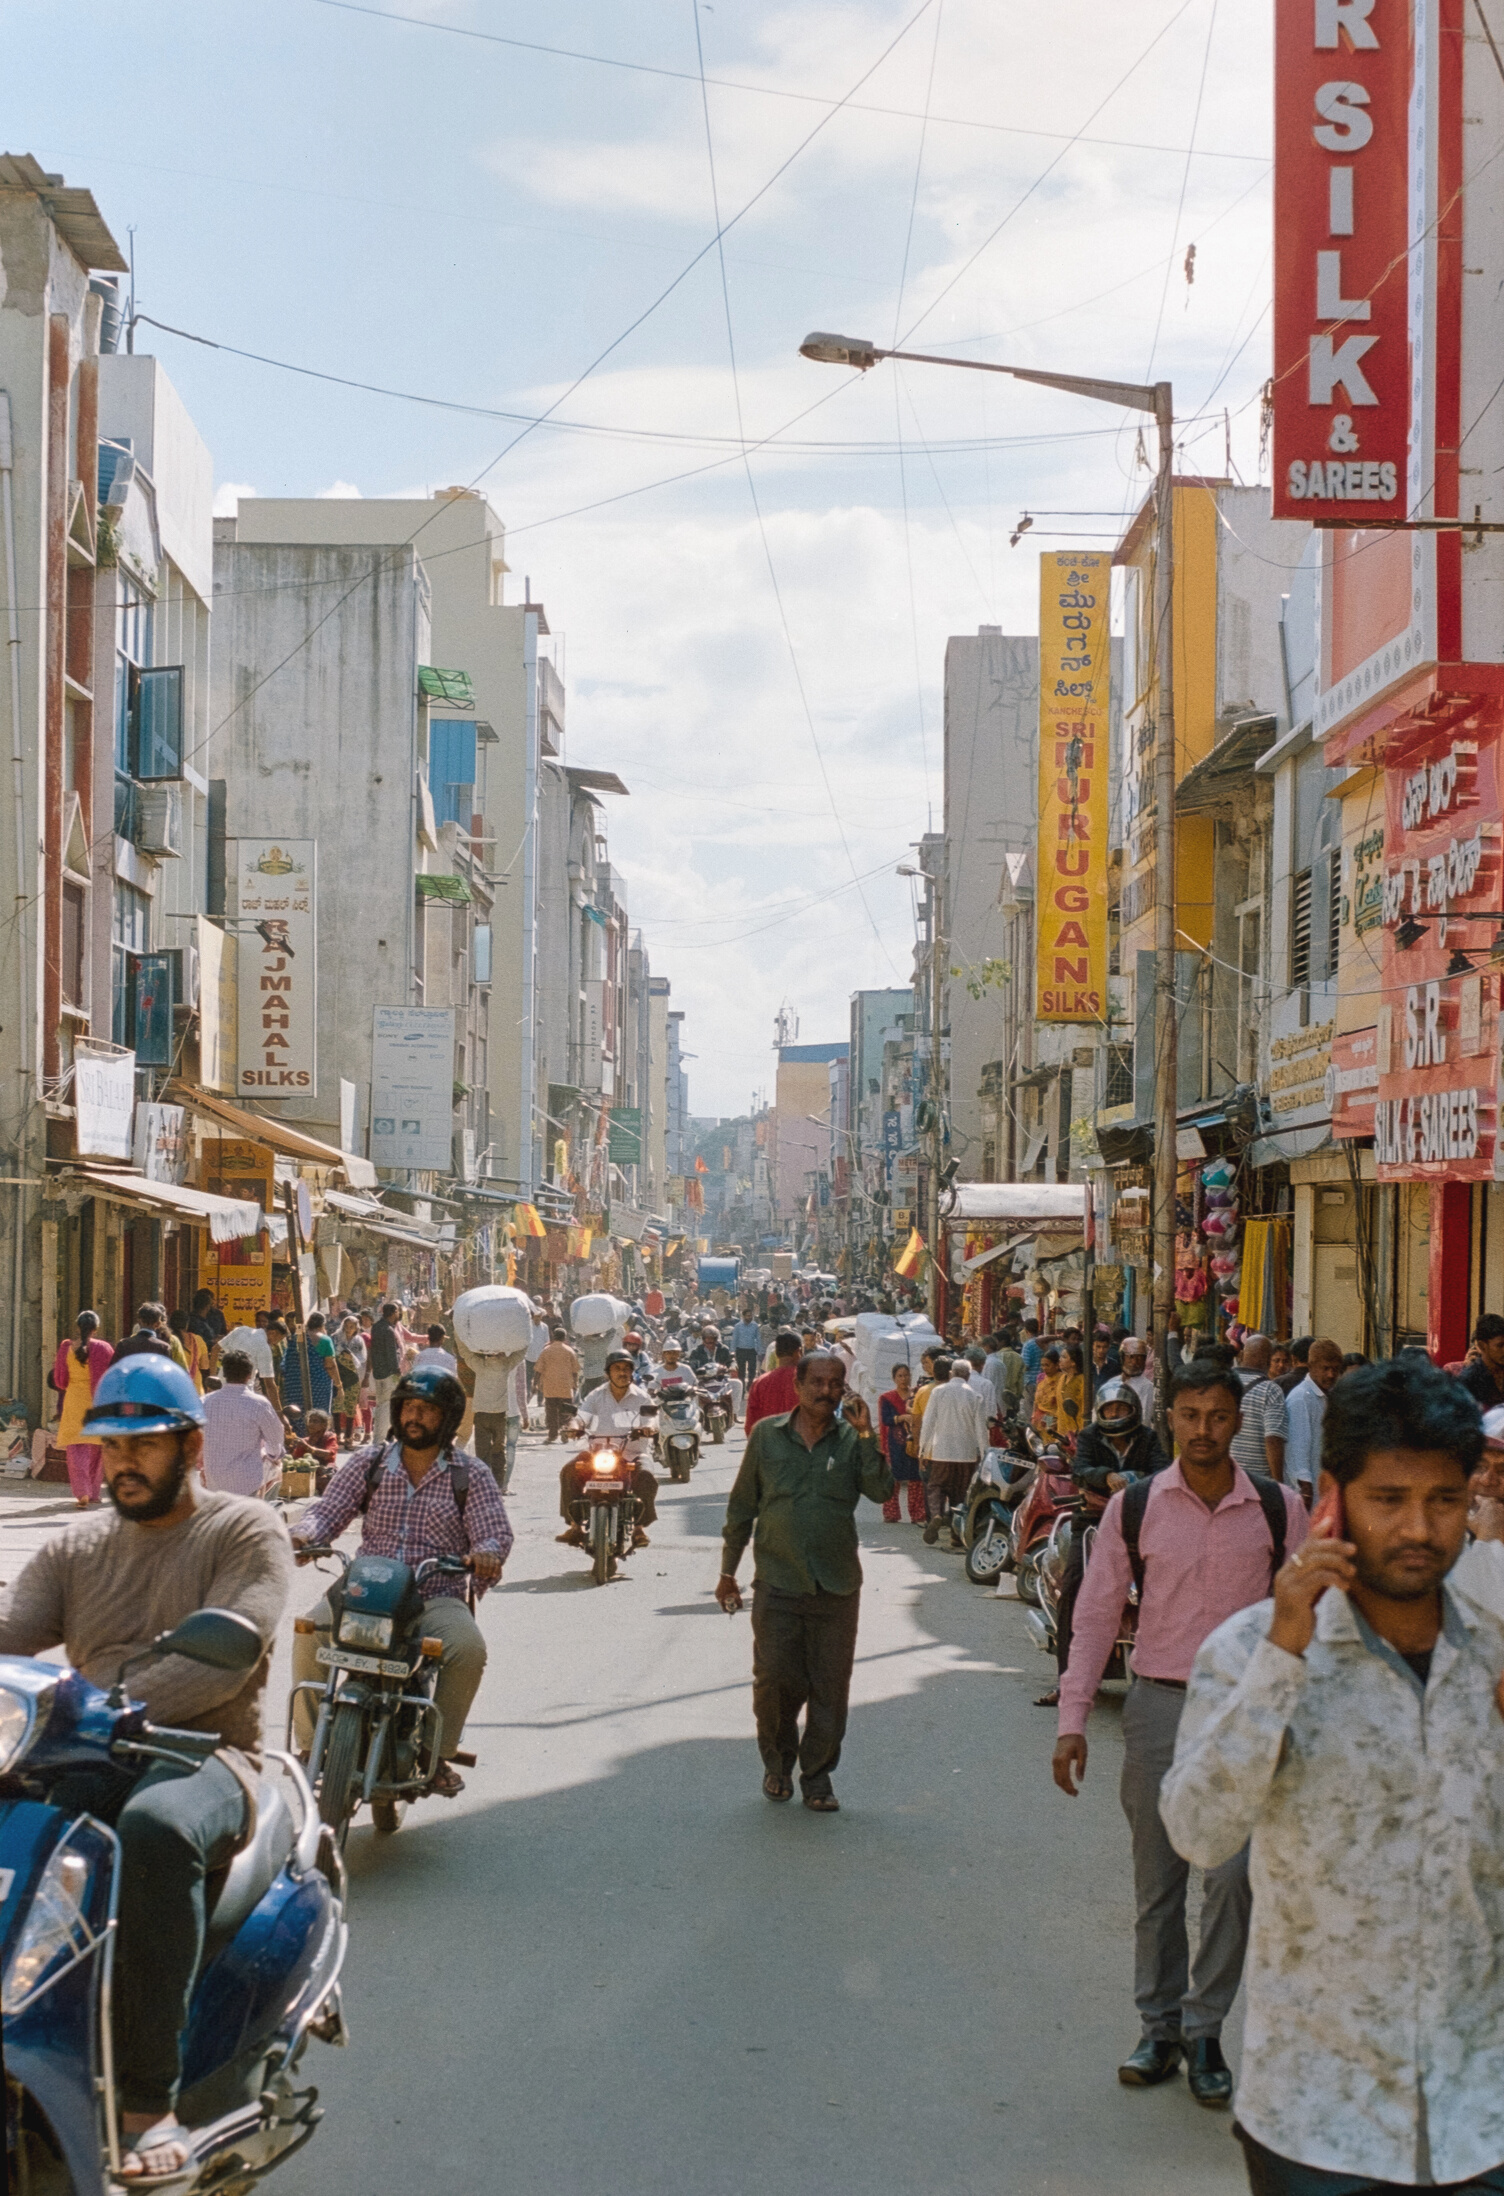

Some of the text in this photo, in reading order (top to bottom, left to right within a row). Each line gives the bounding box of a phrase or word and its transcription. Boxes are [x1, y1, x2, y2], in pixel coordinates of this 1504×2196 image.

[1308, 81, 1380, 406] SILK
[1328, 414, 1360, 453] &
[1288, 460, 1398, 501] SAREES
[1055, 722, 1095, 738] SRI
[1054, 742, 1094, 984] MURUGAN
[1042, 991, 1100, 1013] SILKS
[241, 1070, 310, 1086] SILKS
[1374, 1099, 1403, 1164] SILK
[1420, 1087, 1479, 1162] SAREES
